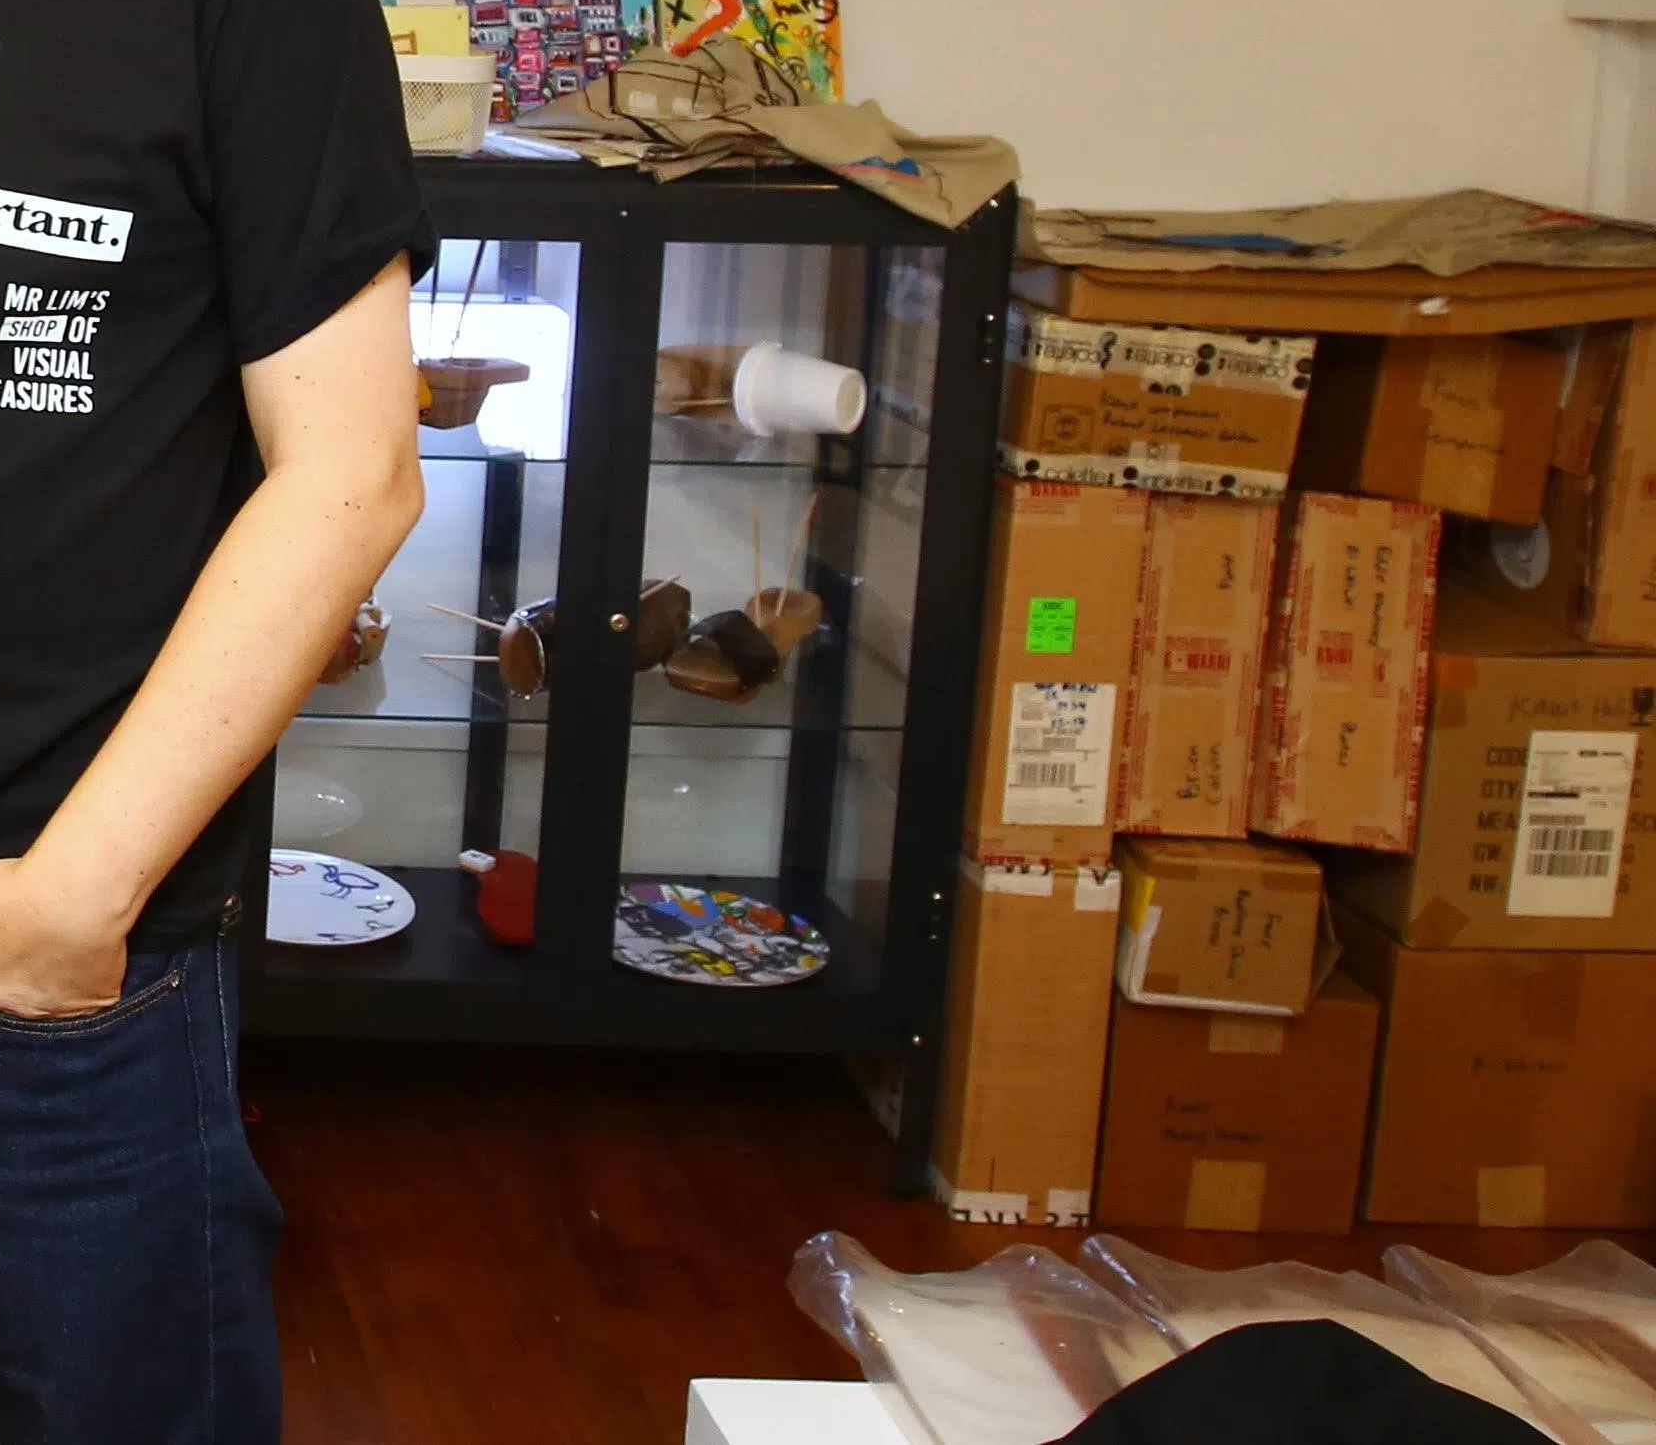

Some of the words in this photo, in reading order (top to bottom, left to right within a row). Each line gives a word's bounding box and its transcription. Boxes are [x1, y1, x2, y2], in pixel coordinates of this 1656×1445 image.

[4, 283, 42, 312] MR
[45, 289, 110, 312] LIM'S
[7, 319, 58, 338] SHOP
[68, 316, 100, 344] OF
[13, 347, 94, 380] VISUAL
